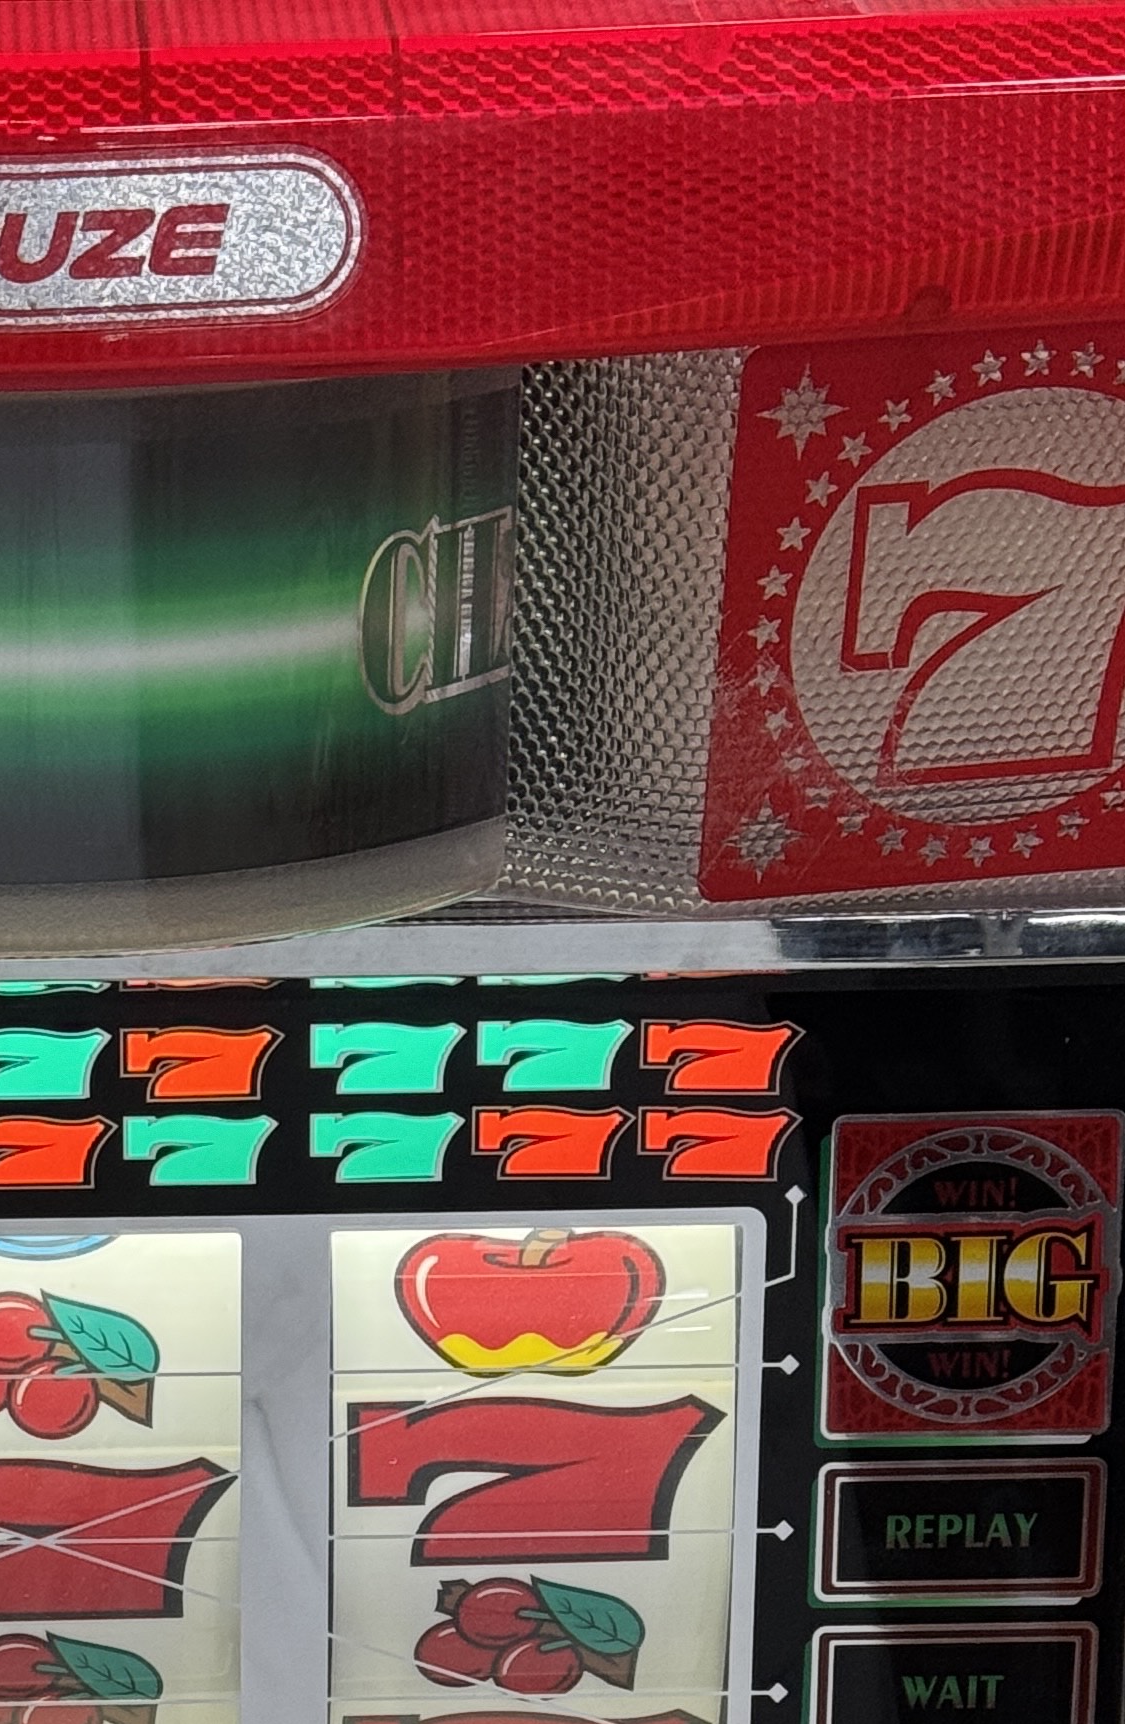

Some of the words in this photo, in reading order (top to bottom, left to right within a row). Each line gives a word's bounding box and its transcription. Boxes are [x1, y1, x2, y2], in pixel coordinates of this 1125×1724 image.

[933, 1177, 1018, 1208] WIN!
[849, 1232, 1094, 1322] BIG
[928, 1350, 1010, 1378] WIN!
[885, 1513, 1038, 1548] REPLAY
[902, 1675, 1004, 1709] WAIT
